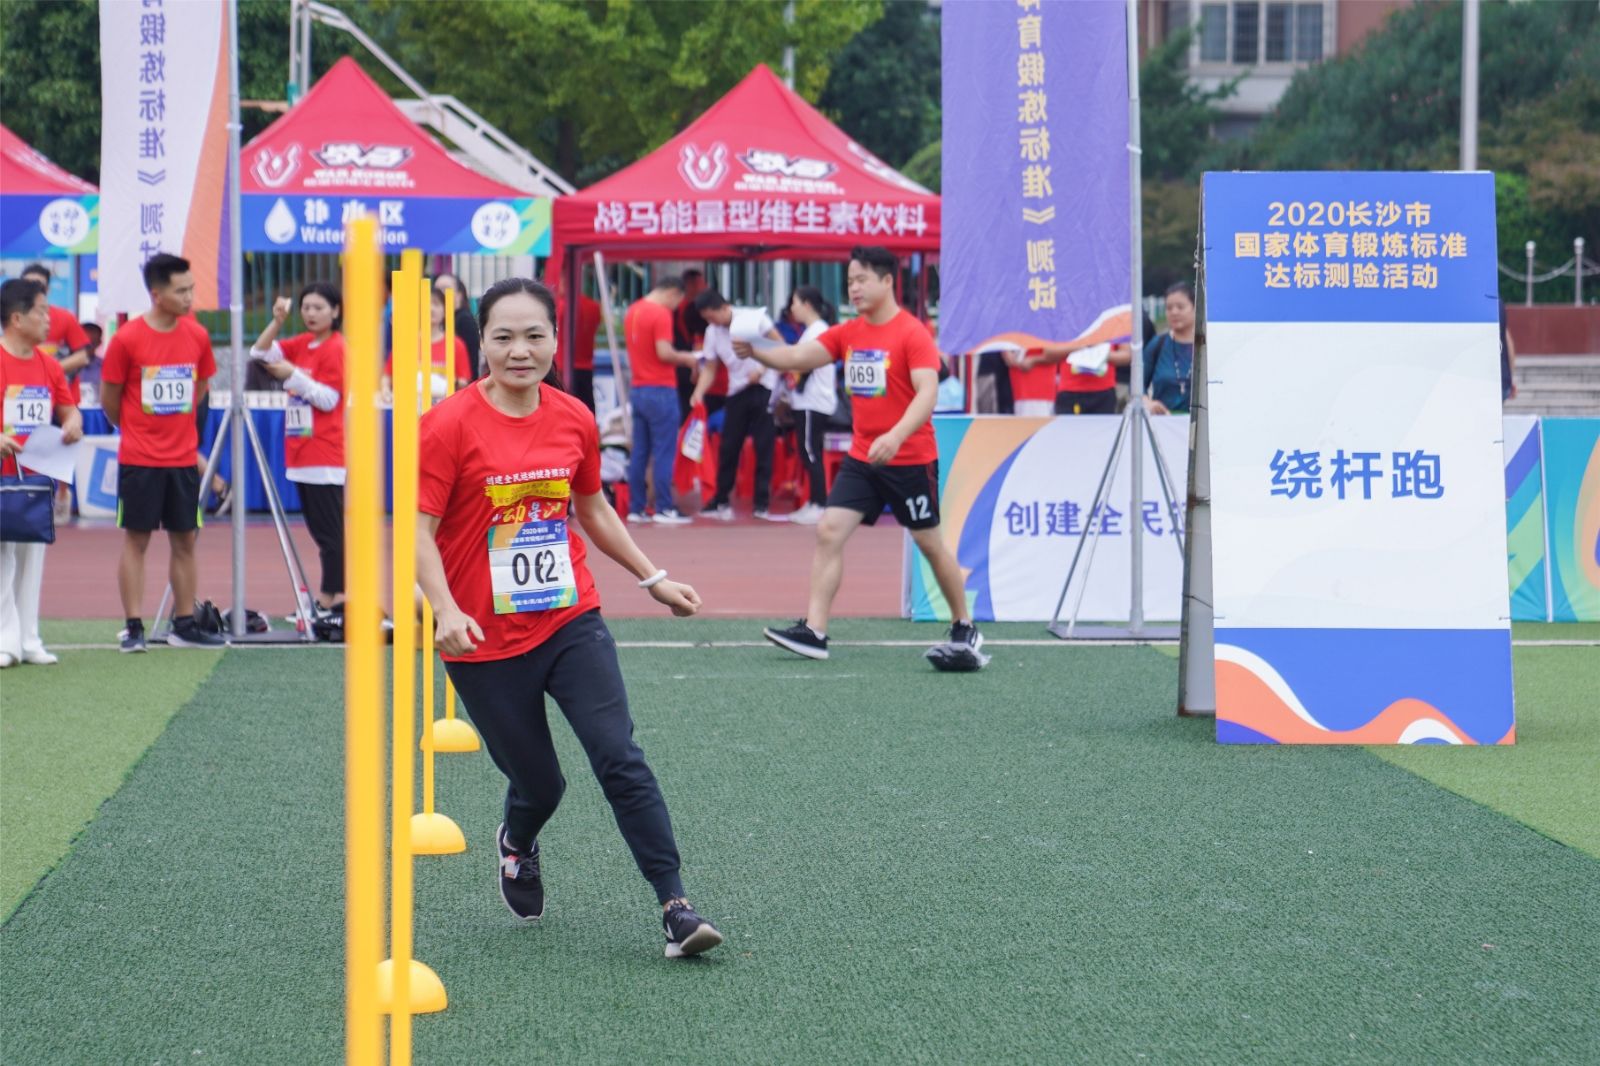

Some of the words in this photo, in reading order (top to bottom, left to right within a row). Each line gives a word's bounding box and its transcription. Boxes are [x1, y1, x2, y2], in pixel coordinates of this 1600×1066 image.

[593, 199, 927, 237] 战马能量型维生素饮料
[1267, 201, 1431, 228] 2020长沙市
[1234, 231, 1468, 259] 国家体育锻炼标准
[1264, 262, 1438, 289] 达标测验活动
[850, 365, 875, 384] 069
[153, 382, 185, 401] 019
[16, 402, 44, 422] 142
[1269, 449, 1445, 500] 绕杆跑
[905, 495, 931, 521] 12
